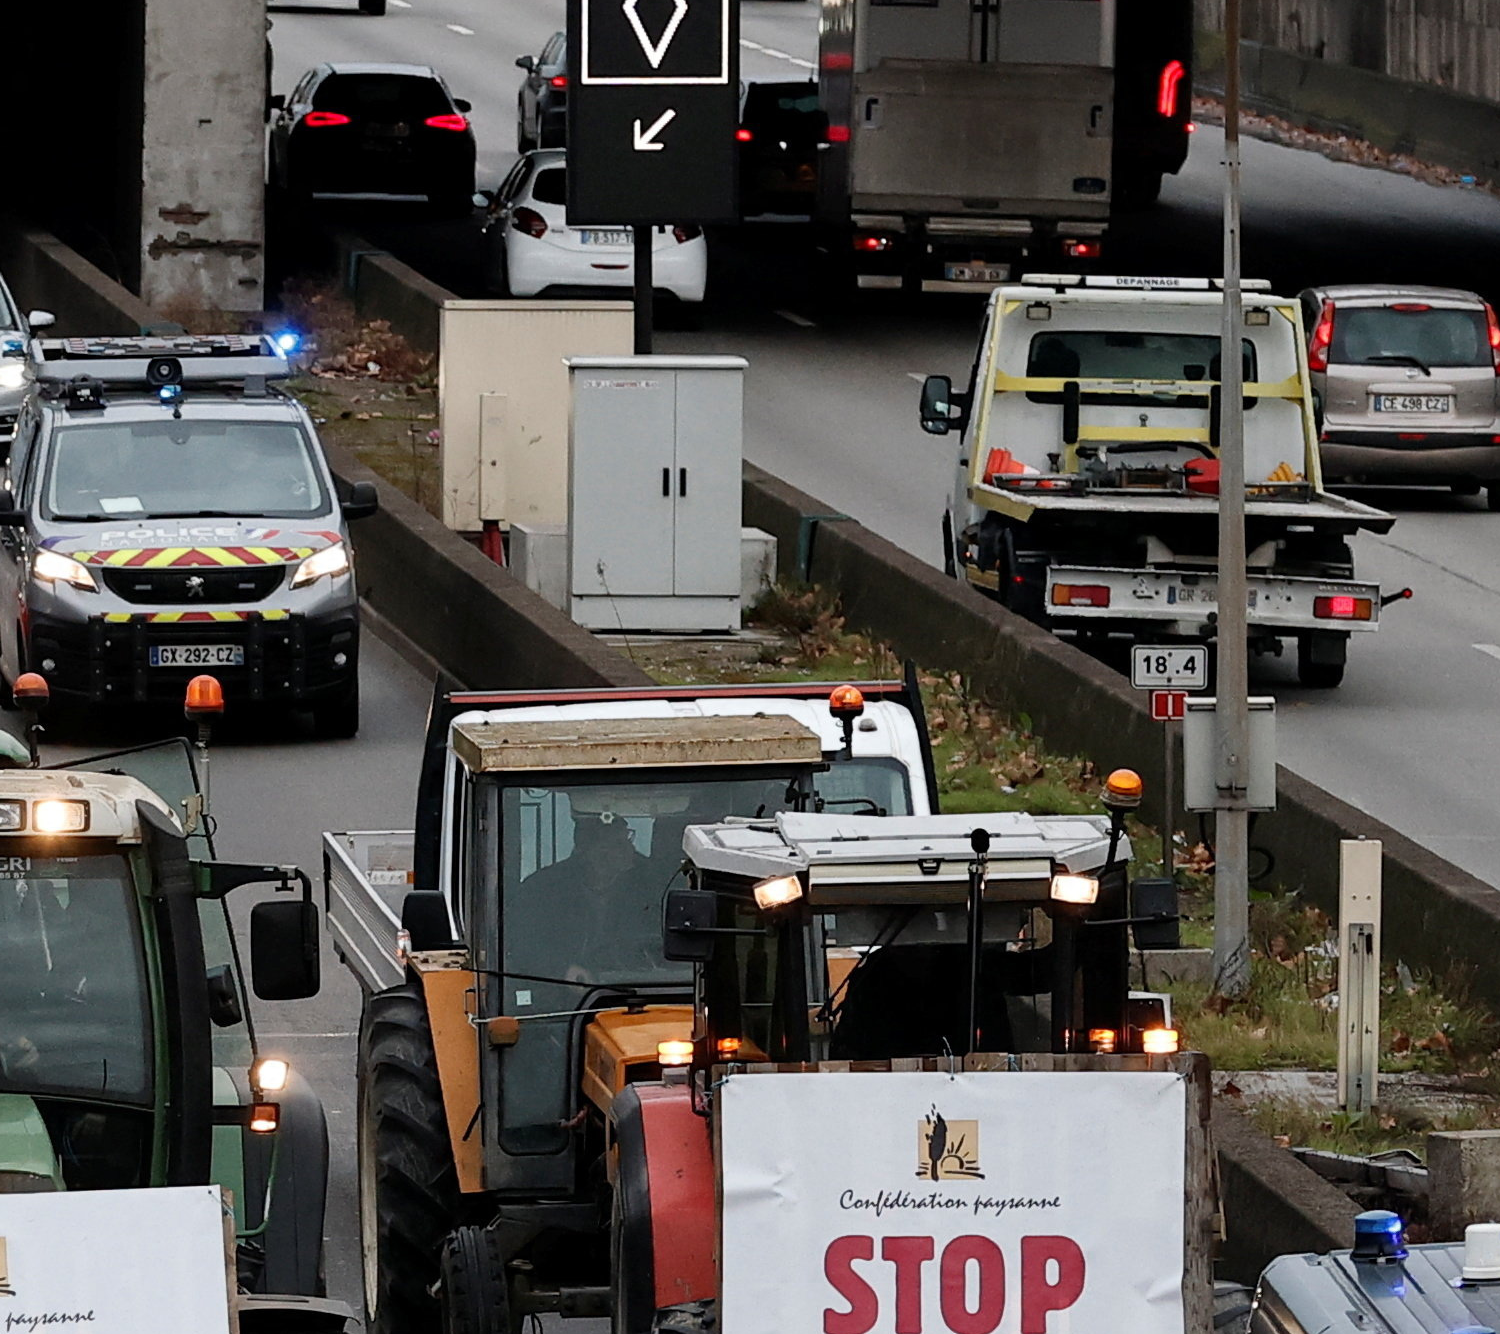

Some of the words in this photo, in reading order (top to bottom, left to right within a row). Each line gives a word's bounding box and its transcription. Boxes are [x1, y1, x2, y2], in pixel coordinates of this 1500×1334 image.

[1116, 278, 1180, 286] DEPANNAGE
[101, 527, 238, 541] POLICE
[840, 1189, 968, 1217] Confédération
[973, 1194, 1062, 1217] paysanne
[5, 1309, 96, 1333] paysanne
